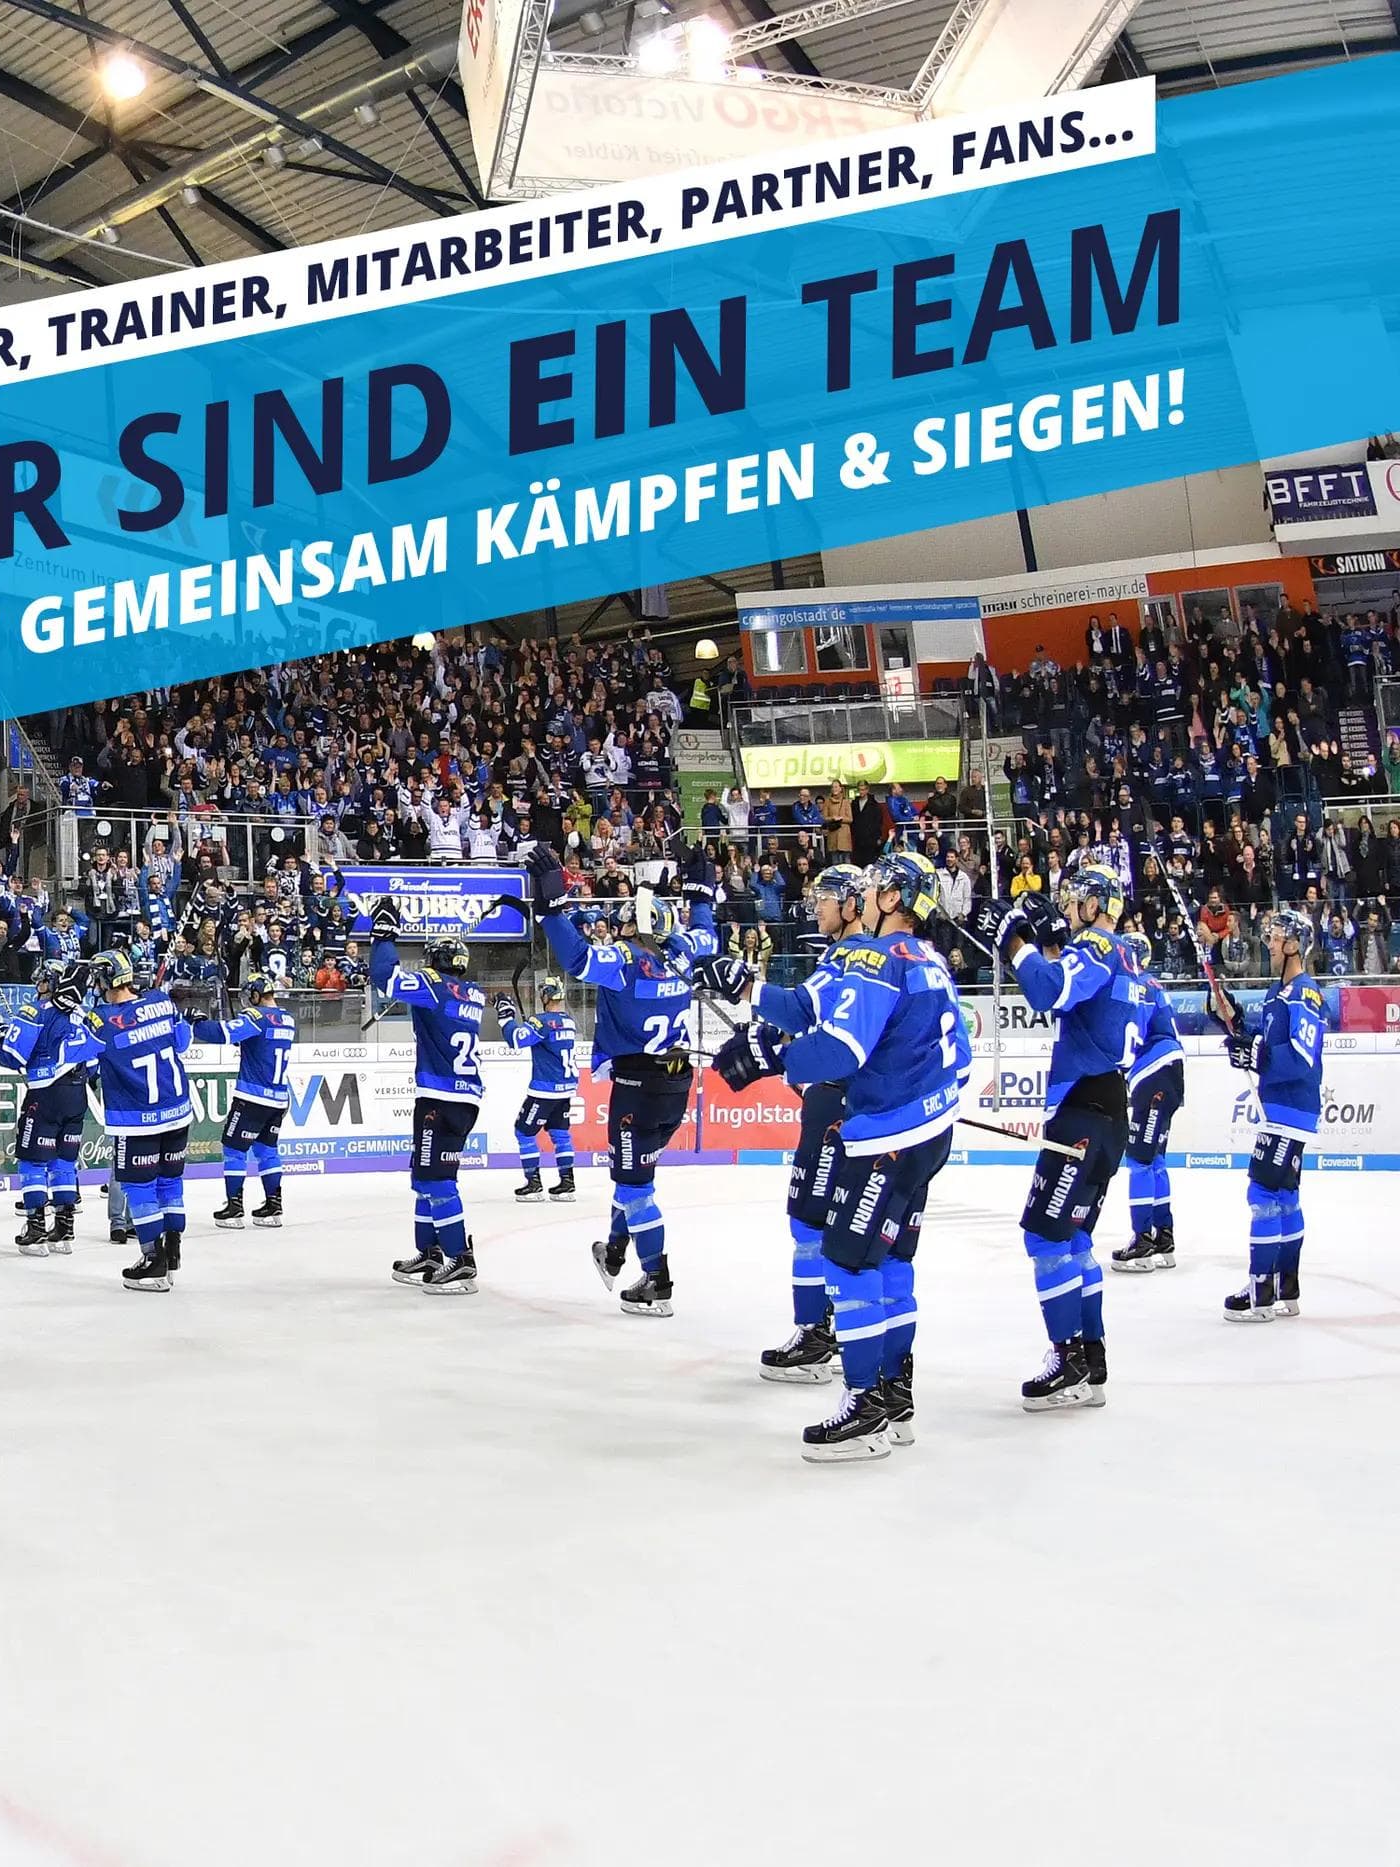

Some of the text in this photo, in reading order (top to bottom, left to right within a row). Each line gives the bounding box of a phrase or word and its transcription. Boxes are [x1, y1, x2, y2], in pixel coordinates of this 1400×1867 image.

[1266, 471, 1363, 505] BFFT
[13, 549, 86, 583] Zentrum
[1336, 553, 1386, 574] SATURN
[1020, 580, 1147, 610] schreinerei-mayr.de
[400, 922, 464, 934] NGOLSTADT
[833, 988, 856, 1019] 2
[1298, 1017, 1317, 1048] 39
[313, 1047, 340, 1058] Audi
[141, 1113, 158, 1124] ERC
[922, 1093, 944, 1117] ERC
[1143, 1108, 1159, 1145] SATURN
[419, 1128, 433, 1167] SATURN
[620, 1131, 632, 1170] SATURN
[811, 1145, 835, 1197] SATURN
[849, 1171, 886, 1235] SATURN
[1045, 1163, 1078, 1219] SATURN
